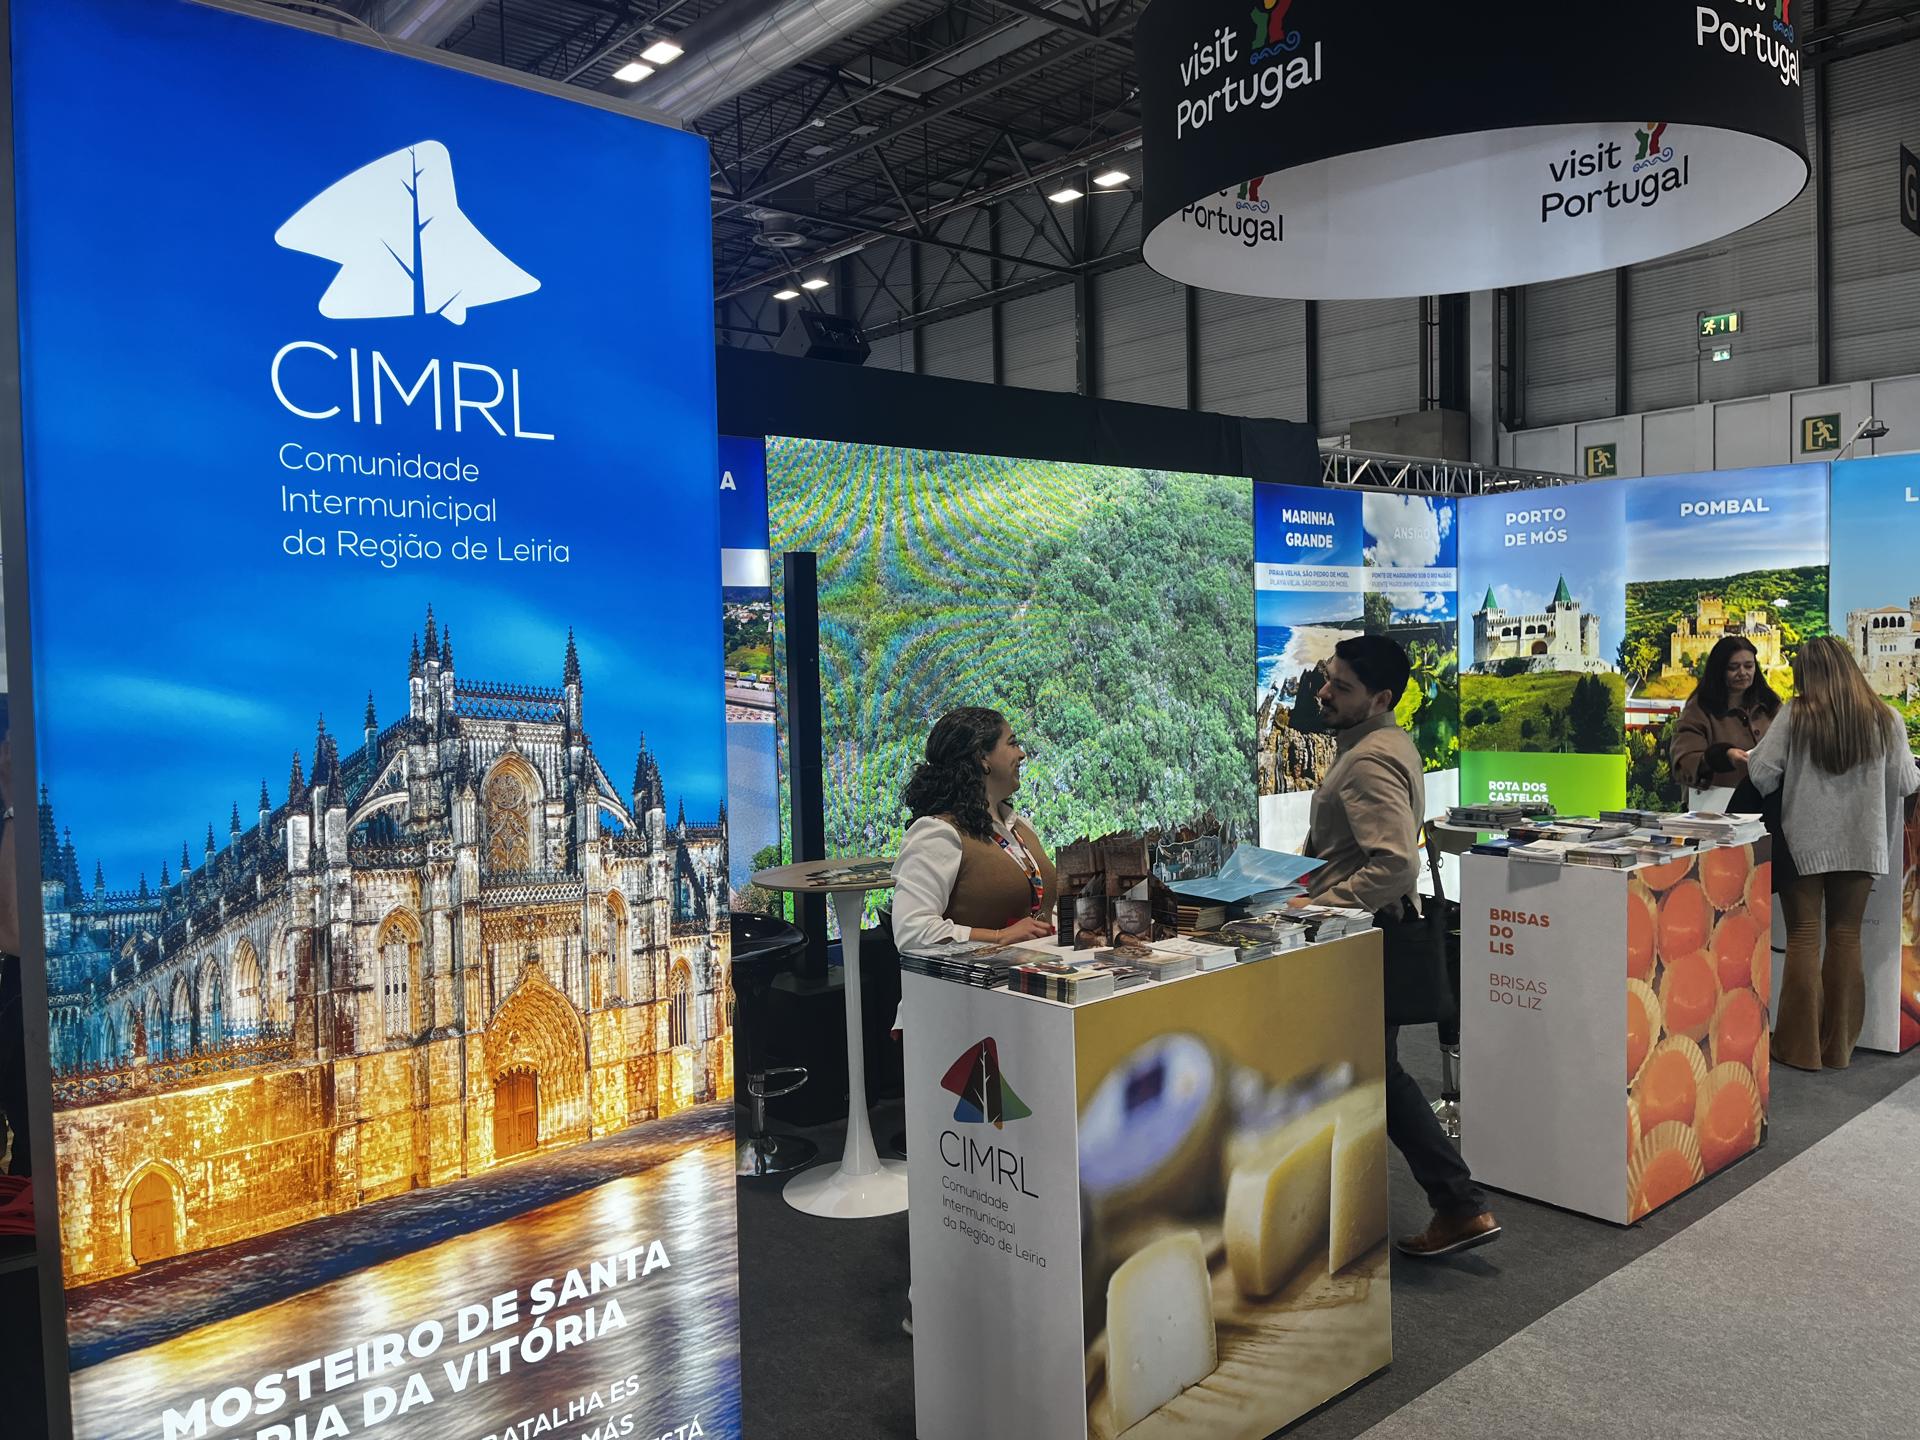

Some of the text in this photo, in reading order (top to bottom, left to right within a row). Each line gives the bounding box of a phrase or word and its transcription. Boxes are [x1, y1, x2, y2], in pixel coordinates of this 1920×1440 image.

[1181, 26, 1238, 87] visit
[1696, 6, 1800, 87] Portugal
[1177, 41, 1322, 139] Portugal
[1549, 142, 1622, 182] visit
[1541, 155, 1689, 223] Portugal
[270, 341, 556, 441] CIMRL
[279, 443, 480, 484] Comunidade
[280, 486, 497, 527] Intermunicipal
[1282, 508, 1336, 527] MARINHA
[1505, 507, 1567, 526] PORTO
[1680, 498, 1771, 517] POMBAL
[282, 529, 571, 568] da Região de Leiria
[1285, 532, 1334, 549] GRANDE
[1504, 527, 1568, 548] DE MÓS
[1488, 781, 1547, 792] ROTA DOS
[1488, 792, 1549, 803] CASTELOS
[1489, 908, 1550, 928] BRISAS
[1489, 924, 1514, 939] DO
[1489, 940, 1515, 956] LIS
[1489, 973, 1548, 995] BRISAS
[1489, 989, 1543, 1011] DO LIZ
[939, 1130, 1039, 1199] CIMRL
[941, 1175, 1009, 1213] Comunidade
[942, 1194, 1016, 1236] Intermunicipal
[943, 1215, 1047, 1269] da Região de Leiria
[161, 1239, 671, 1440] MOSTEIRO DE SANTA
[362, 1372, 435, 1428] DA
[443, 1299, 628, 1393] VITÓRIA
[610, 1375, 640, 1404] ES
